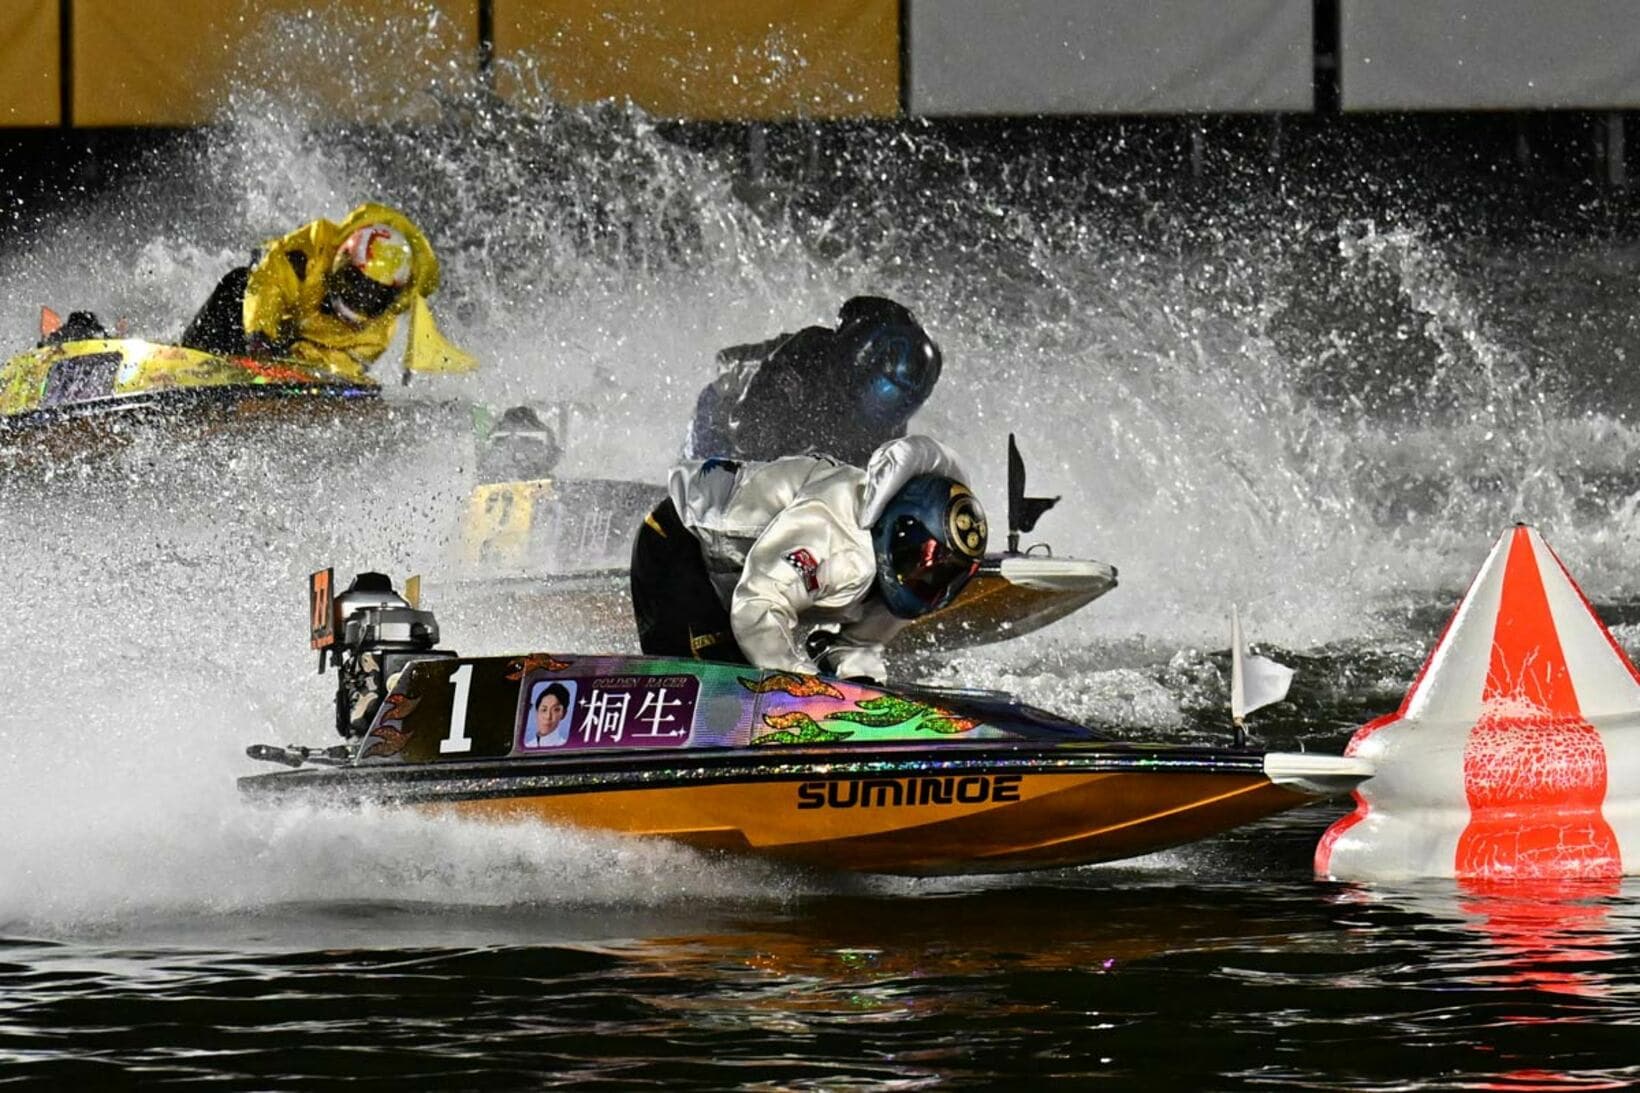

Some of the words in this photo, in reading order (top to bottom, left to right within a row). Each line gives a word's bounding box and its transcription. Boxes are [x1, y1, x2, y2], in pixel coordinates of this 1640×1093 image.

[645, 677, 688, 688] RACER
[440, 664, 473, 753] 1
[579, 688, 682, 743] 桐生
[797, 775, 1024, 810] SUMINOE
